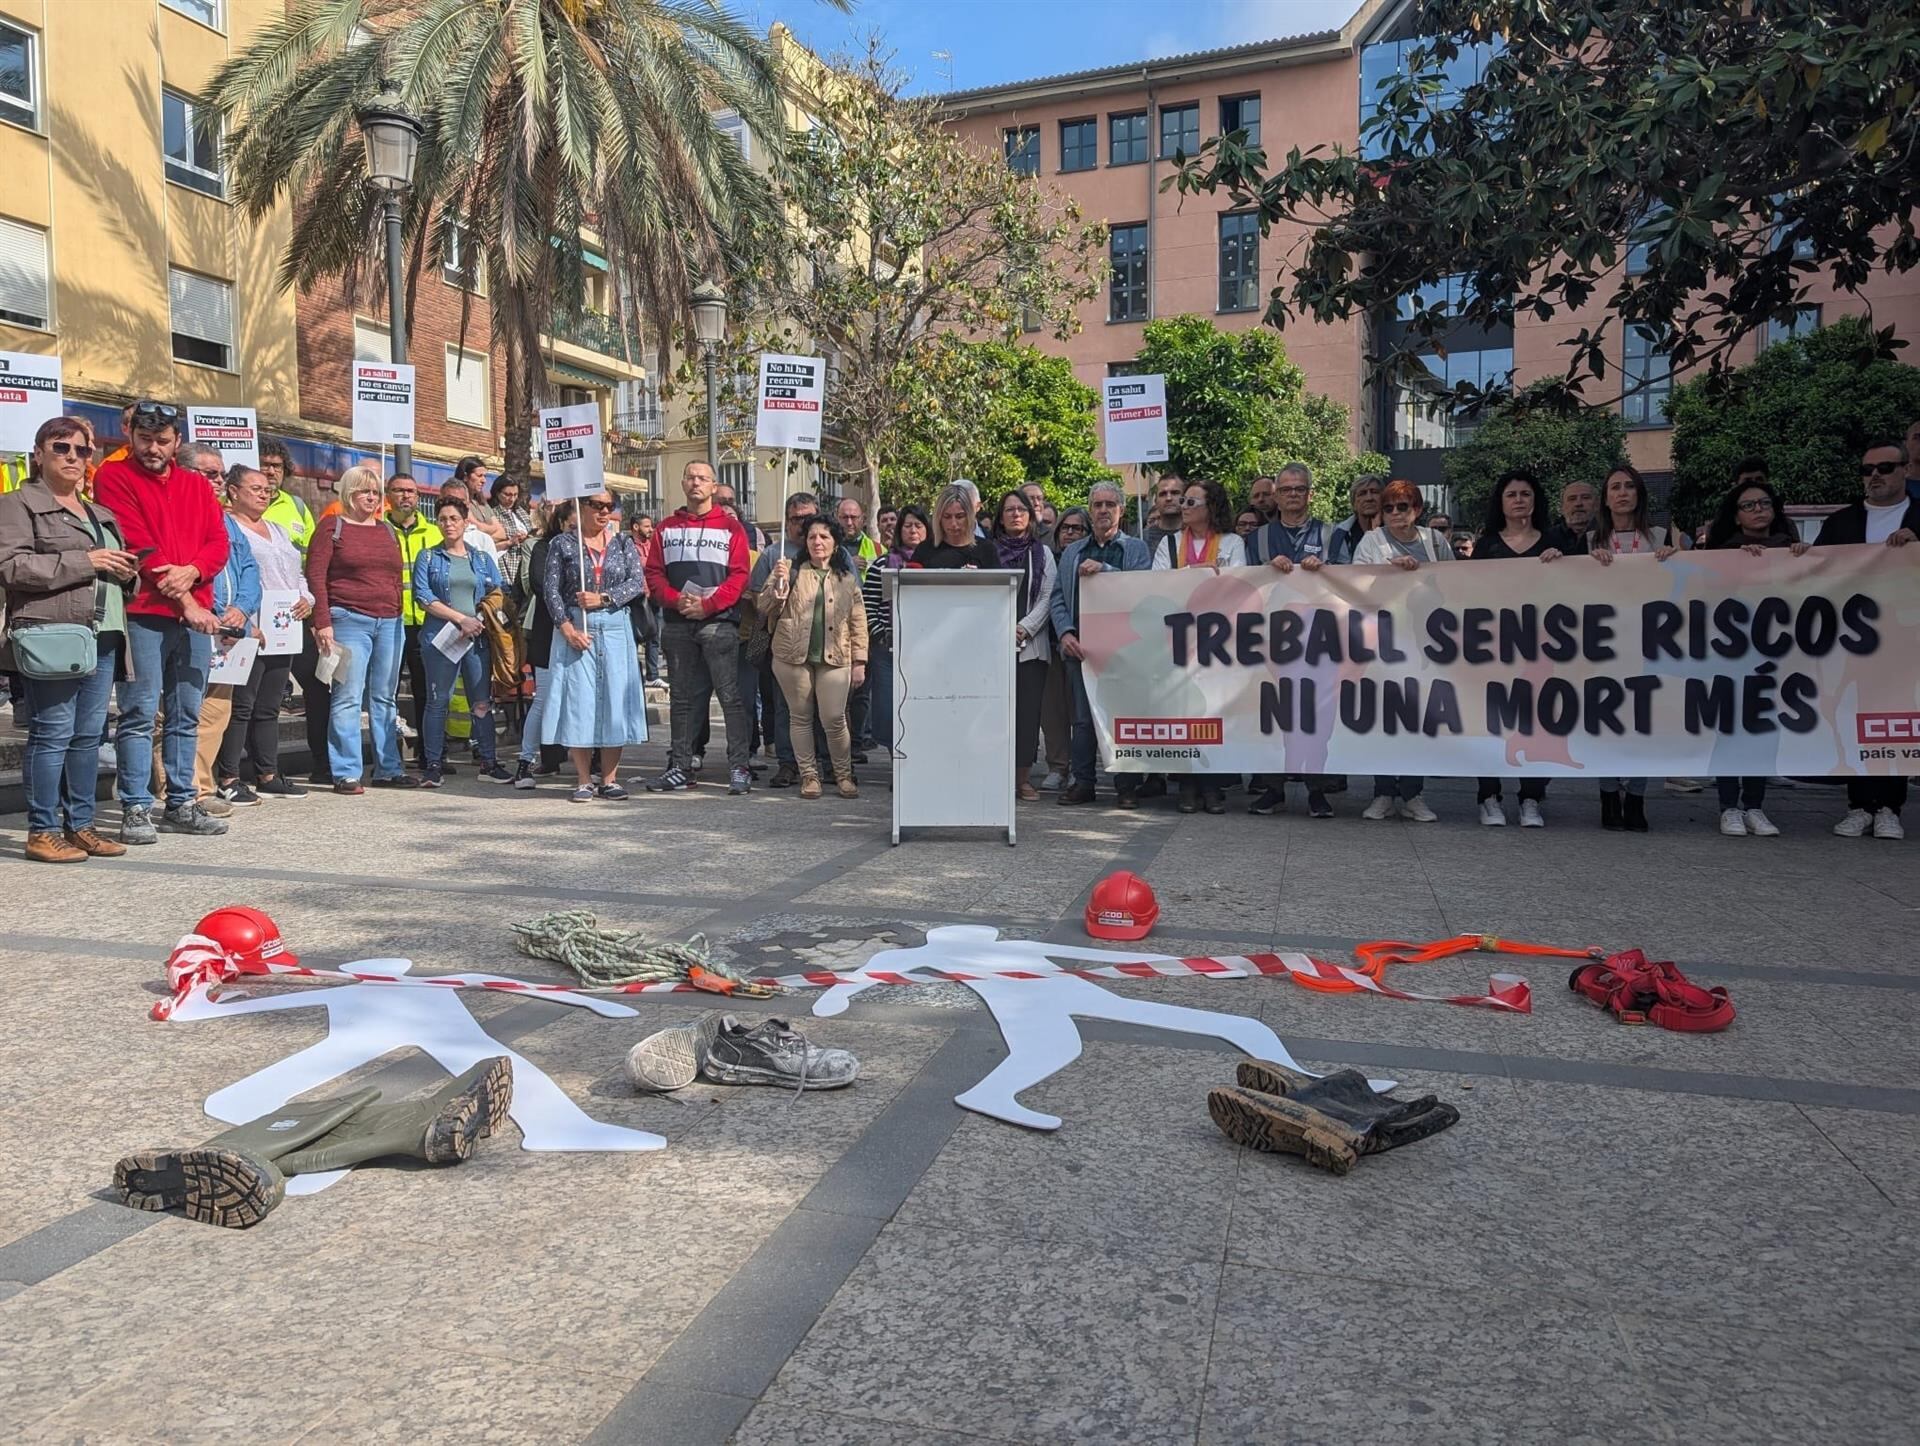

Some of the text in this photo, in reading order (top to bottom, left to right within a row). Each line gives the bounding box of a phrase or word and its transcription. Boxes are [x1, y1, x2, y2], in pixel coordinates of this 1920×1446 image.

[361, 368, 393, 378] La salut
[770, 363, 807, 374] No hi ha
[0, 376, 56, 389] recarietat
[361, 380, 372, 388] no
[383, 382, 410, 391] canvia
[769, 376, 803, 386] recanvi
[768, 389, 784, 397] per
[1110, 385, 1142, 395] La salut
[360, 392, 406, 402] per diners
[767, 399, 816, 410] la teua vida
[196, 415, 245, 426] Protegim la
[1110, 408, 1161, 422] primer lloc
[547, 418, 560, 427] No
[197, 428, 251, 438] salut mental
[548, 427, 592, 439] més morts
[222, 440, 251, 449] treball
[550, 440, 569, 450] en el
[550, 449, 578, 462] treball
[1164, 593, 1880, 667] TREBALL SENSE RISCOS
[1260, 661, 1819, 737] NI UNA MORT MÉS
[1119, 723, 1188, 740] CCOO
[1115, 747, 1201, 759] país valencià
[1860, 747, 1896, 761] país
